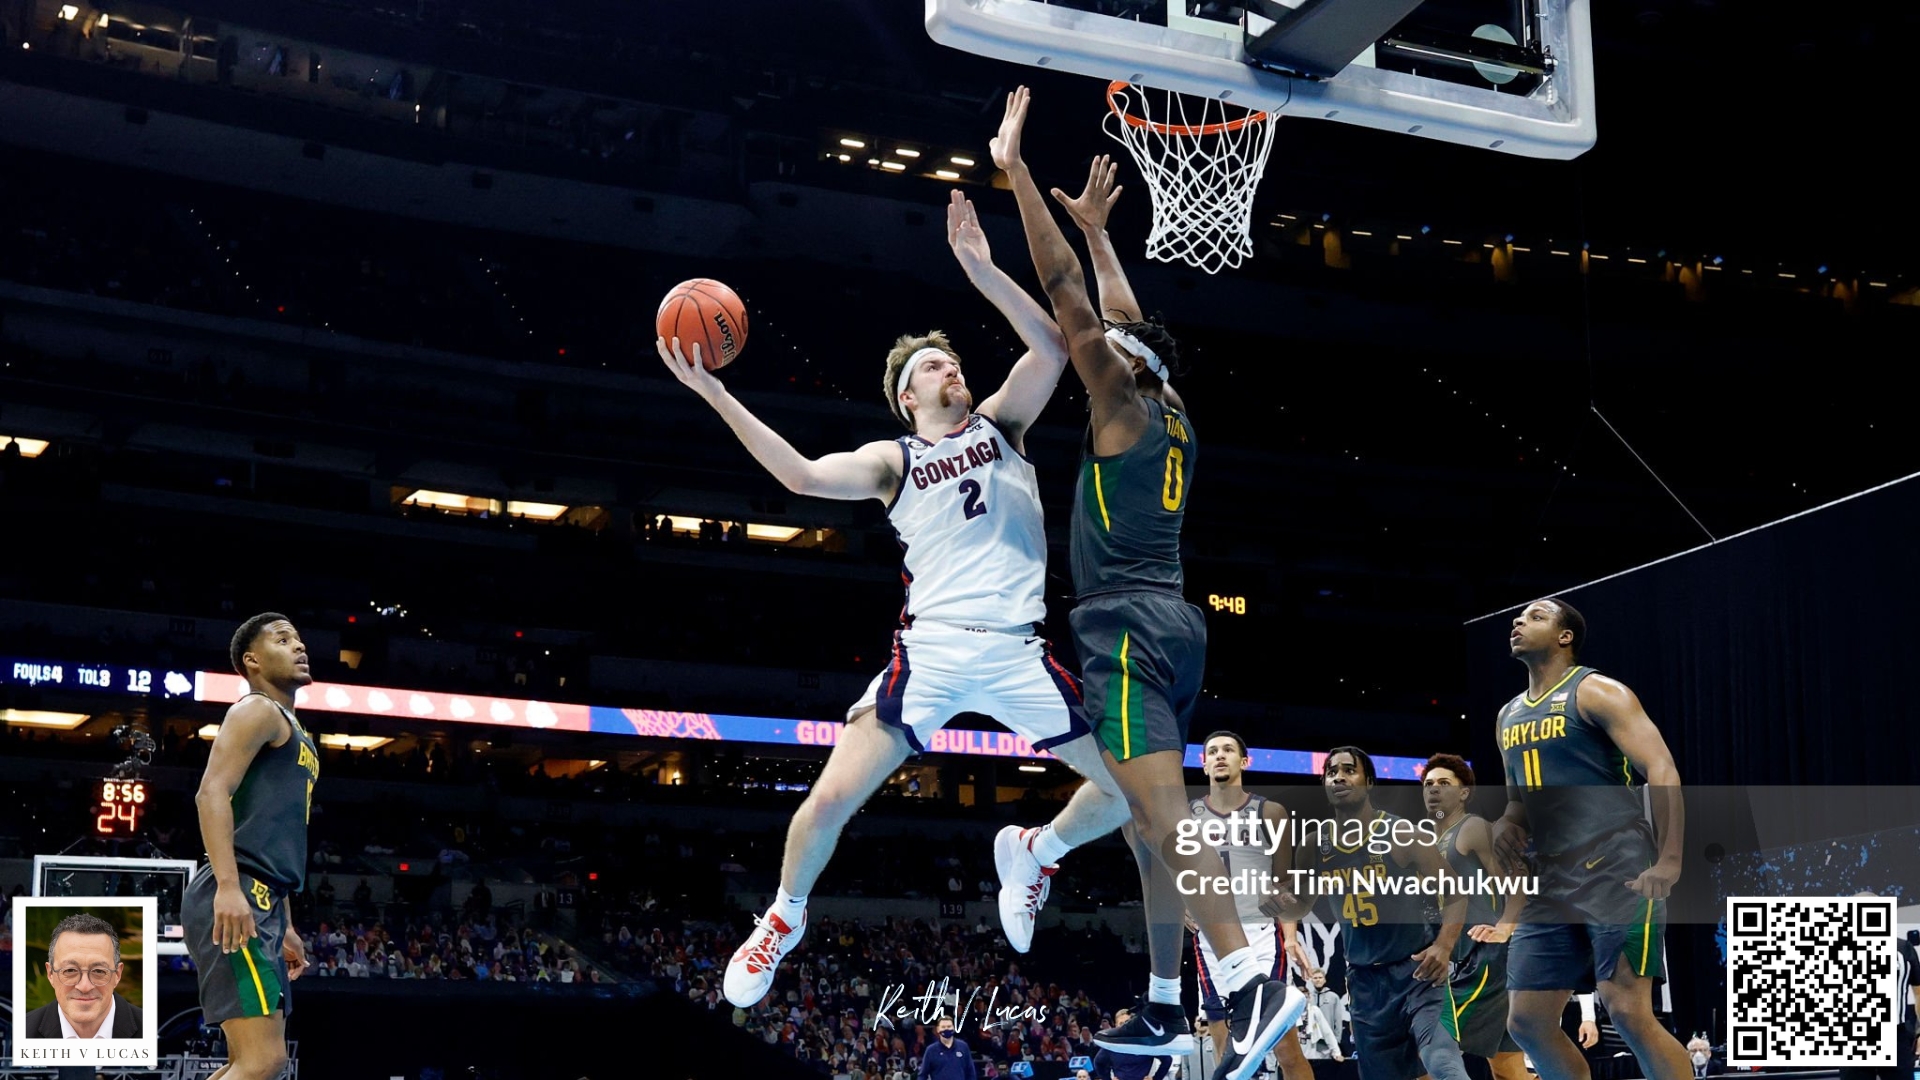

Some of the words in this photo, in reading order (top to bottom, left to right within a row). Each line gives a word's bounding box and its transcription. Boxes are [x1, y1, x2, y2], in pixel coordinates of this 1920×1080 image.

[911, 437, 1003, 491] GONZAGA
[1162, 447, 1185, 511] 0
[959, 479, 987, 520] 2
[1209, 594, 1245, 614] 9:48
[127, 669, 152, 692] 12
[931, 730, 1058, 759] BULLDO
[1502, 715, 1566, 750] BAYLOR
[1523, 748, 1542, 793] 11
[103, 783, 145, 803] 8:56
[97, 802, 135, 832] 24
[942, 903, 963, 915] 139
[1342, 891, 1379, 928] 45
